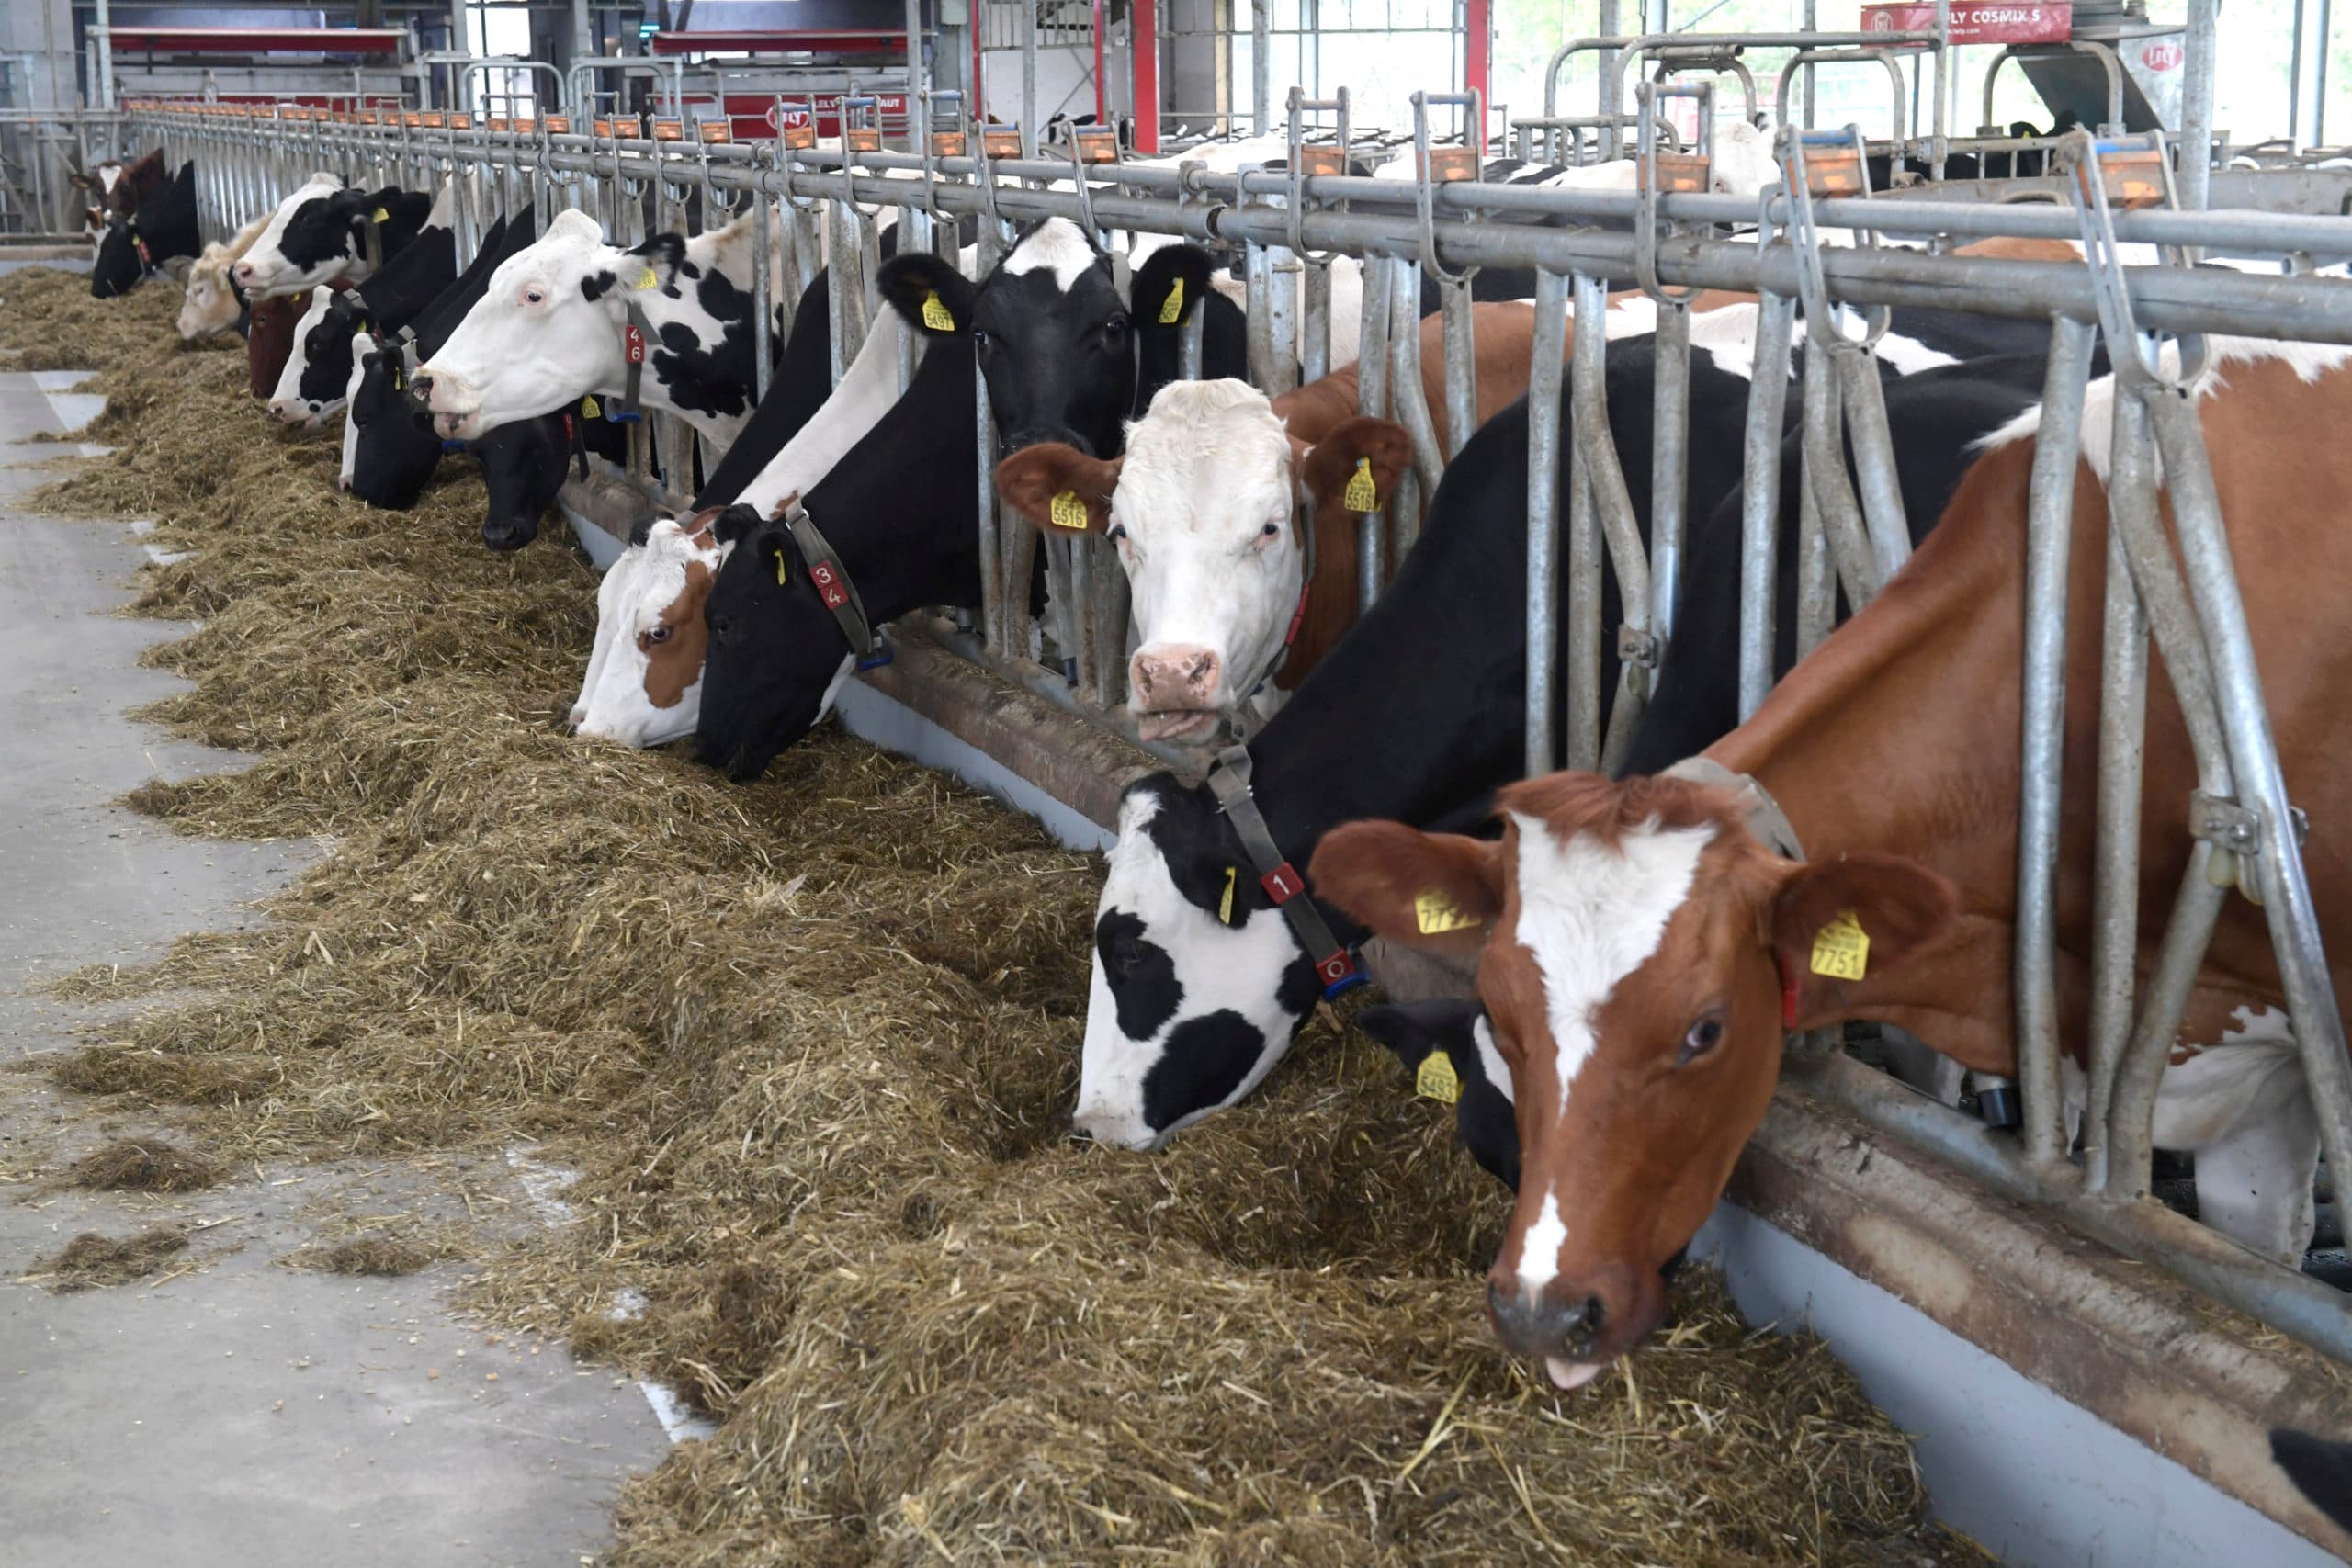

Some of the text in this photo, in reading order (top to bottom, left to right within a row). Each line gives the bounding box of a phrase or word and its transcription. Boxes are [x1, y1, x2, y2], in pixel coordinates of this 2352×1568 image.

[1971, 9, 2027, 24] COSMIX
[2031, 9, 2041, 22] S
[925, 312, 950, 329] 5497
[630, 328, 640, 343] 4
[631, 346, 641, 361] 6
[1347, 491, 1373, 510] 5516
[1054, 506, 1083, 526] 5516
[816, 567, 831, 584] 3
[829, 588, 842, 603] 4
[1272, 874, 1290, 895] 1
[1814, 947, 1860, 976] 7751
[1420, 1075, 1453, 1100] 5493
